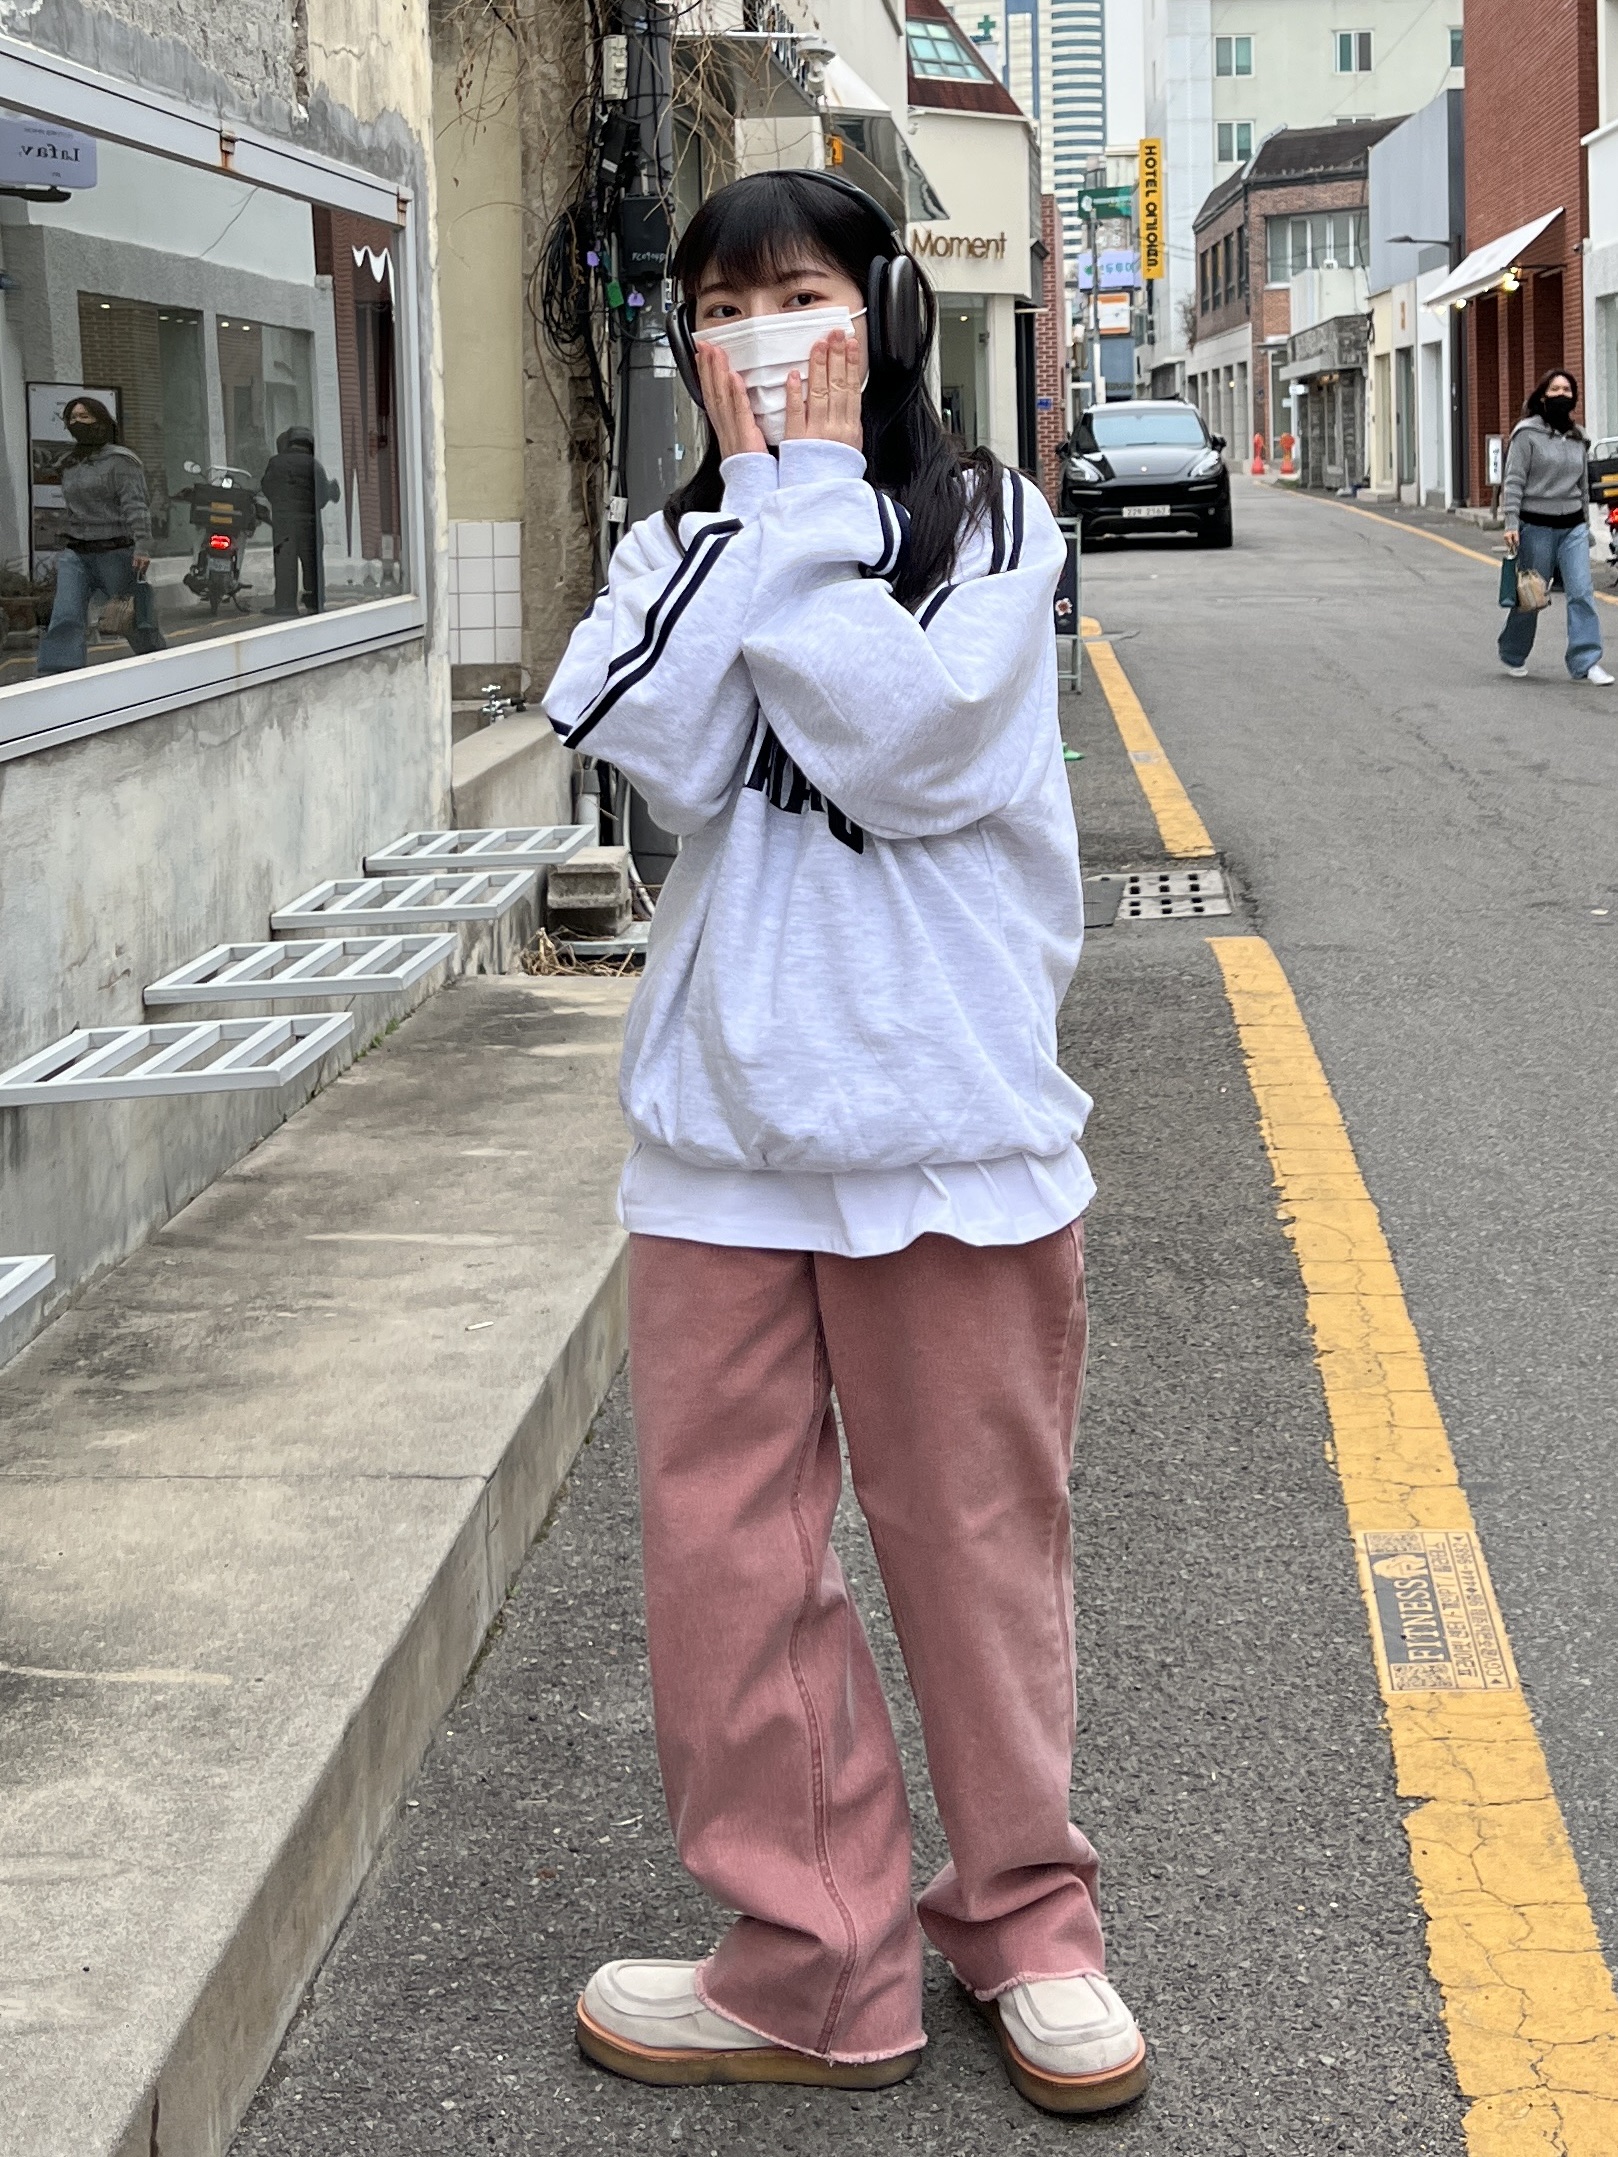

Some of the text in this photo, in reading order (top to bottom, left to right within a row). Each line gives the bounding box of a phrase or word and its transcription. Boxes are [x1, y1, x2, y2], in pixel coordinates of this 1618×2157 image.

[1145, 145, 1158, 198] HOTEL
[911, 228, 1008, 259] Moment
[1393, 1578, 1445, 1662] FITNESS
